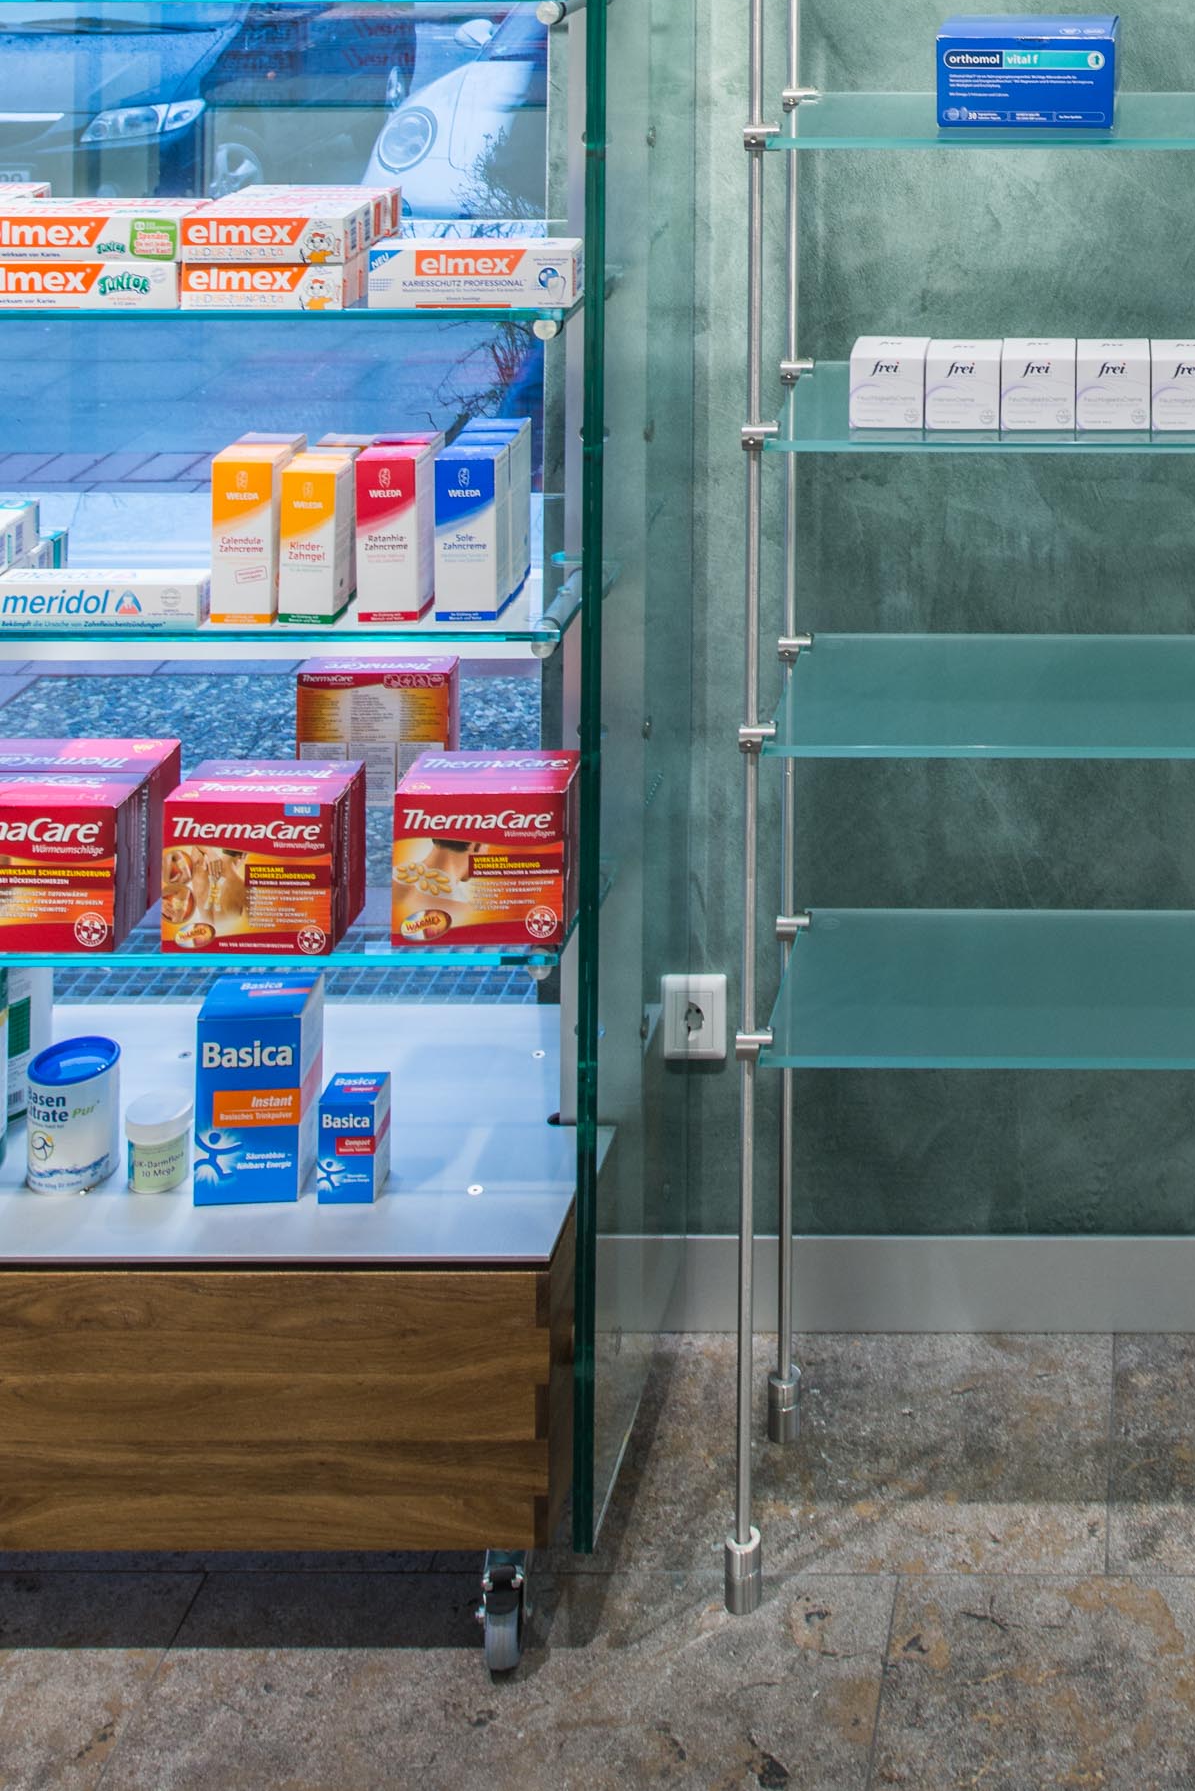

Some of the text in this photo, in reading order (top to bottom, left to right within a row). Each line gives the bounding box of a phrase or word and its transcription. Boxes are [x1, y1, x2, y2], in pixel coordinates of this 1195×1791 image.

[949, 54, 1039, 65] orthomol vital f
[0, 220, 91, 246] lmex
[187, 220, 293, 244] elmex
[370, 252, 390, 268] NEU
[420, 253, 512, 275] elmex
[0, 267, 87, 292] lmex
[187, 267, 293, 290] elmex
[402, 279, 524, 288] KARIESSCHUTZ PROFESSIONAL
[870, 360, 901, 377] frei
[945, 362, 976, 378] frei
[1021, 361, 1052, 378] frei
[1096, 361, 1127, 378] frei
[226, 491, 260, 501] WELEDA
[368, 489, 402, 498] WELEDA
[448, 489, 481, 498] WELEDA
[292, 500, 324, 509] WELEDA
[221, 536, 264, 545] Calendula-
[368, 535, 408, 543] Ratanhia-
[455, 534, 477, 542] Sole-
[219, 545, 264, 553] Zahncreme
[290, 541, 324, 551] Kinder-
[364, 543, 409, 551] Zahncreme
[443, 542, 488, 551] Zahncreme
[288, 551, 326, 563] Zahngel
[2, 589, 110, 614] meridol
[302, 674, 354, 683] ThermaCare
[424, 758, 570, 769] ThermaCare
[293, 806, 312, 814] NEU
[402, 808, 552, 830] ThermaCare
[172, 817, 321, 841] ThermaCare
[32, 844, 105, 856] Wärmeumschläge
[240, 981, 284, 990] Basica
[201, 1039, 293, 1069] Basica
[334, 1077, 377, 1086] Basica
[251, 1095, 293, 1108] Instant
[29, 1104, 69, 1123] itrate
[322, 1113, 370, 1128] Basica
